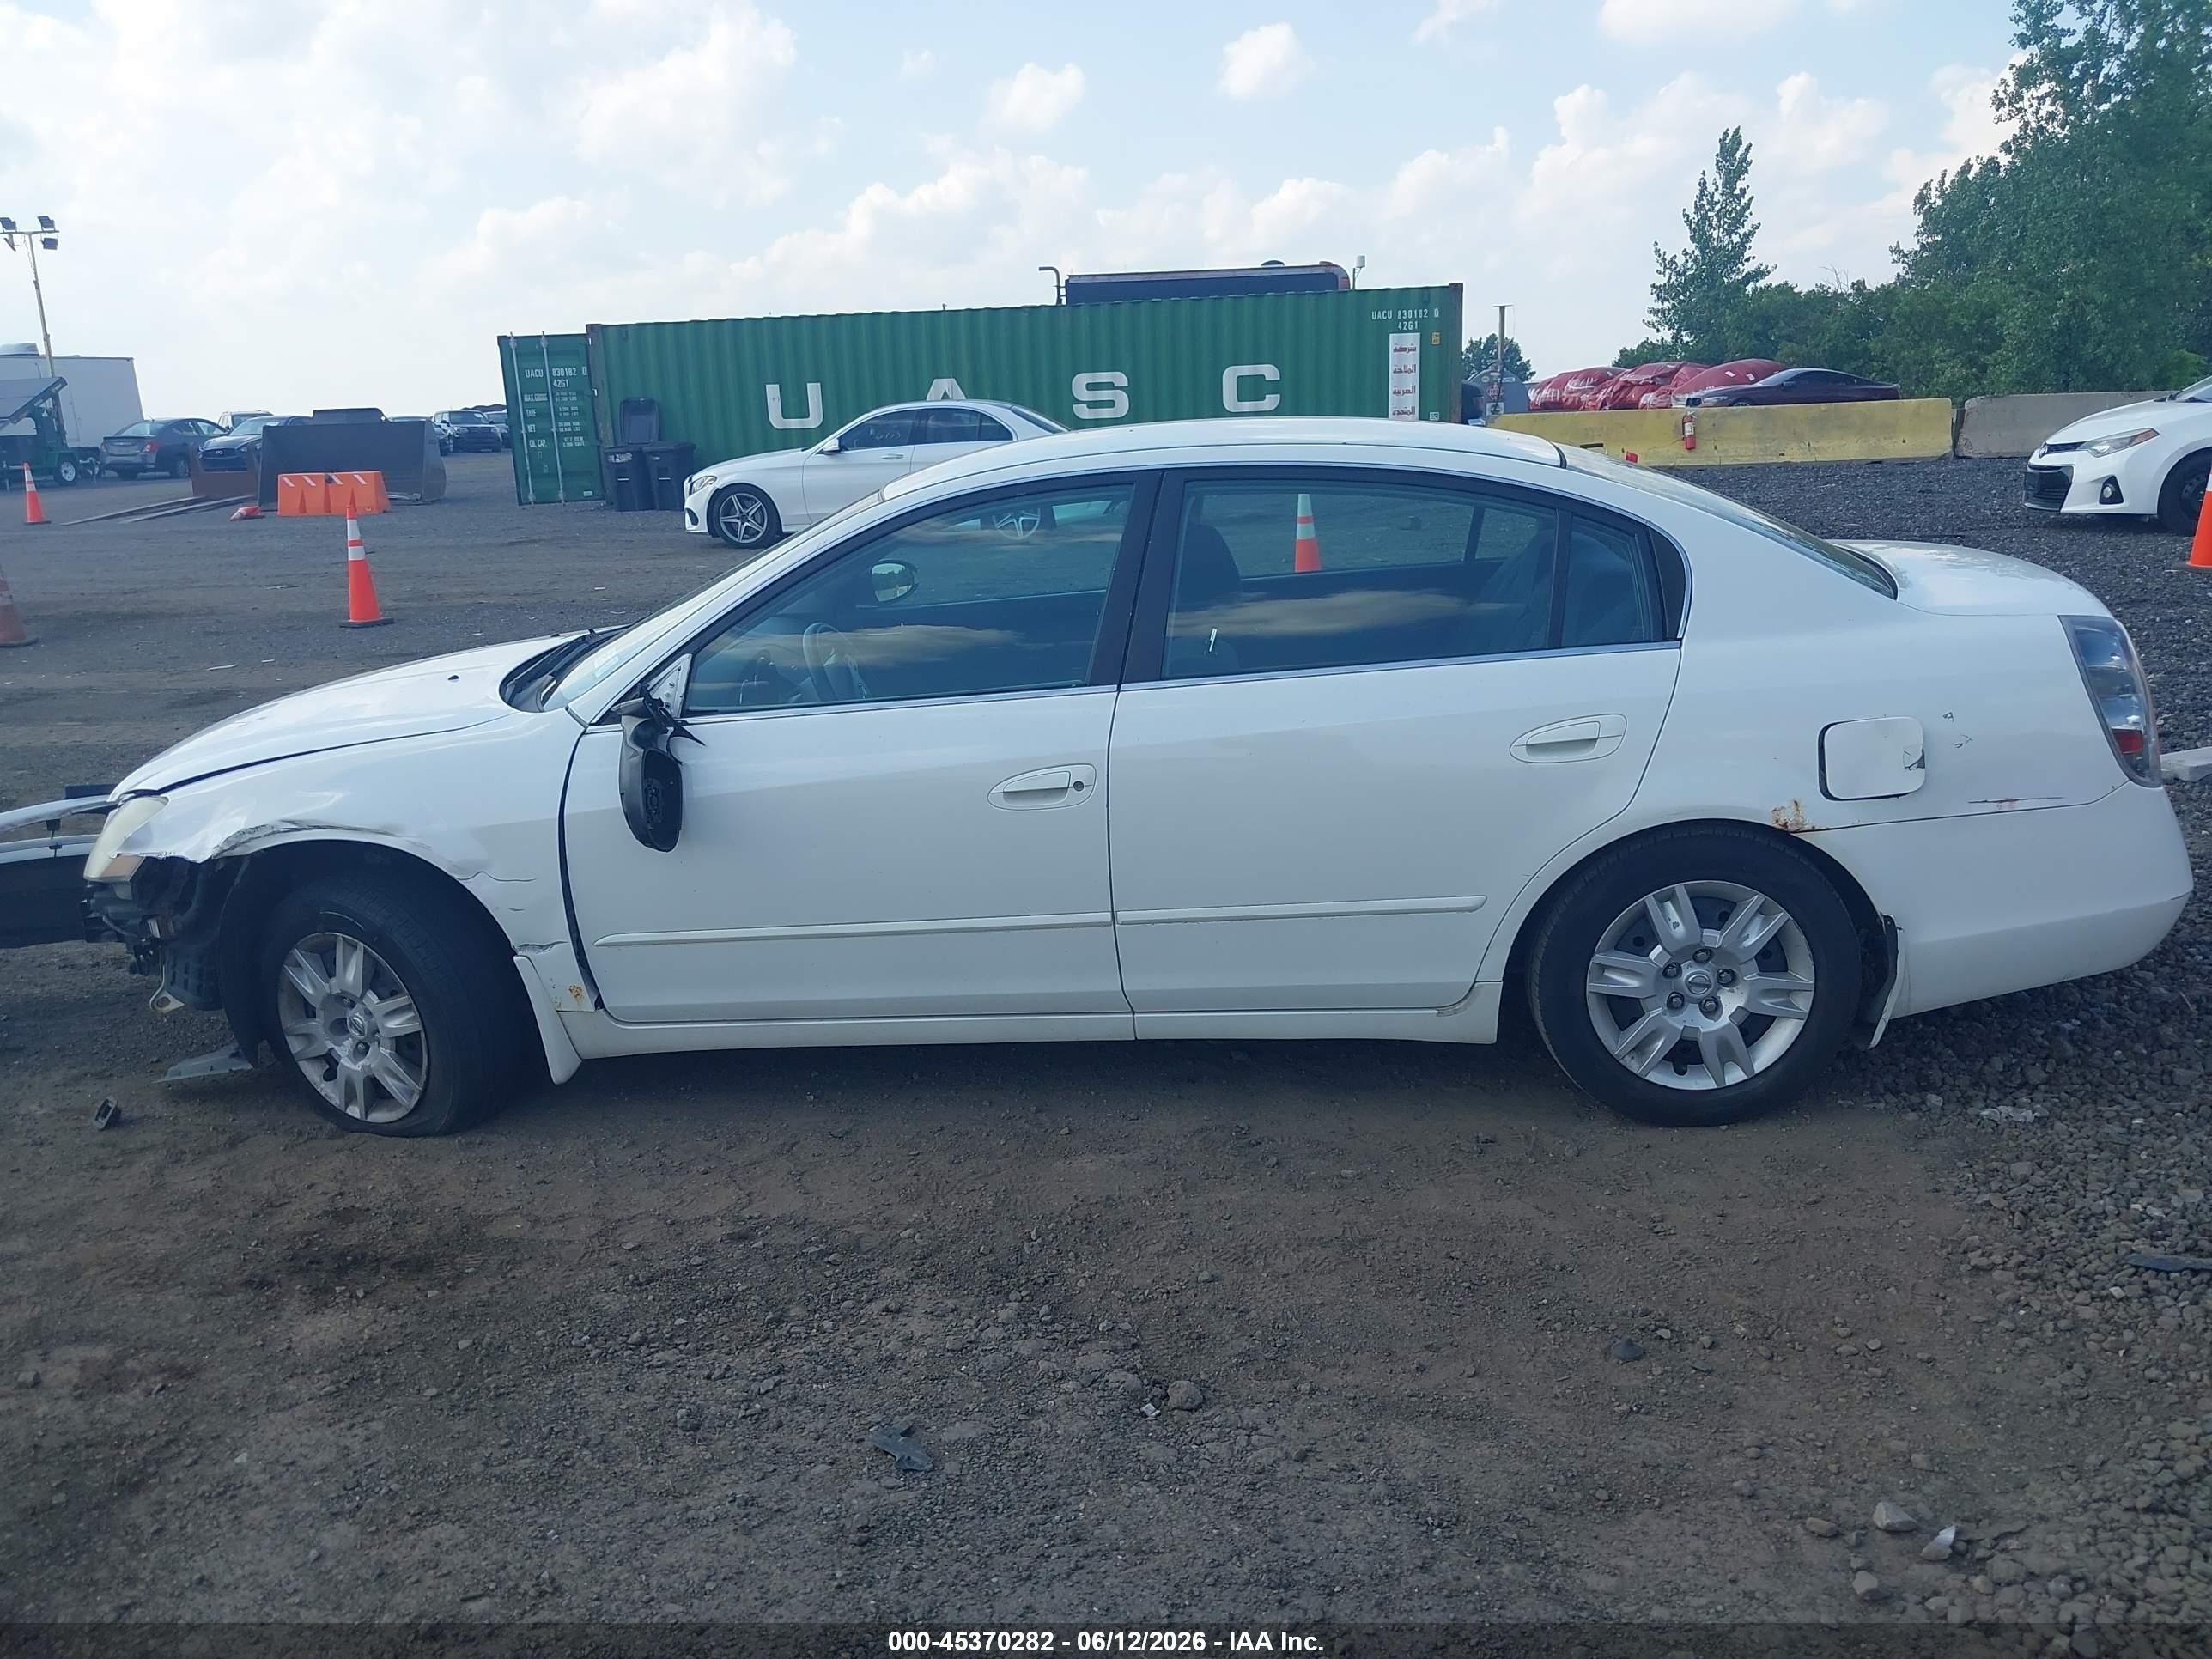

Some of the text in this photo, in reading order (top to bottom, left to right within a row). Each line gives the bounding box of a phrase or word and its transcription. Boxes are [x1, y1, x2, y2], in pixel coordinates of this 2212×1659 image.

[1371, 310, 1393, 320] UACU
[1397, 308, 1428, 319] 830182
[1397, 320, 1419, 331] 42G1
[525, 368, 544, 379] UACU
[552, 367, 577, 377] 830182
[553, 379, 569, 388] 42G1
[765, 382, 823, 429] U
[1072, 371, 1130, 420] S
[1222, 363, 1280, 413] C
